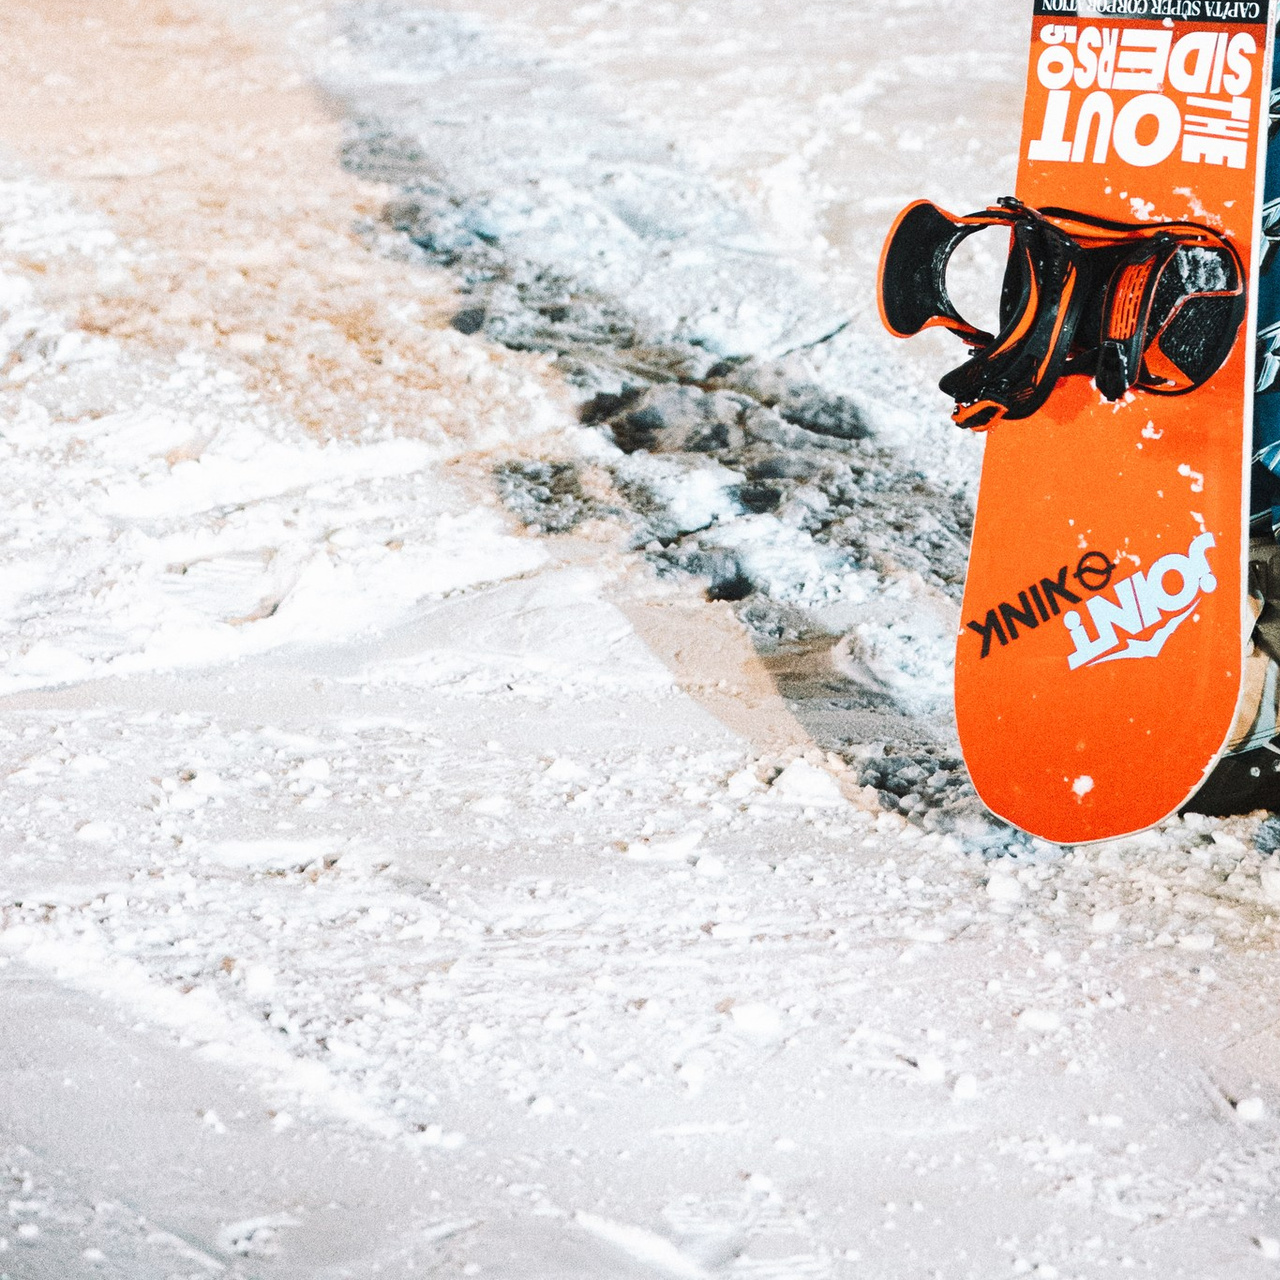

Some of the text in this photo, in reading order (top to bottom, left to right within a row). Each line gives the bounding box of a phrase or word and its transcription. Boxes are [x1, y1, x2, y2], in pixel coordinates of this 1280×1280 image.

[1073, 26, 1257, 96] SIDERS
[1027, 90, 1252, 169] THE OUT
[1062, 531, 1218, 671] JOINT
